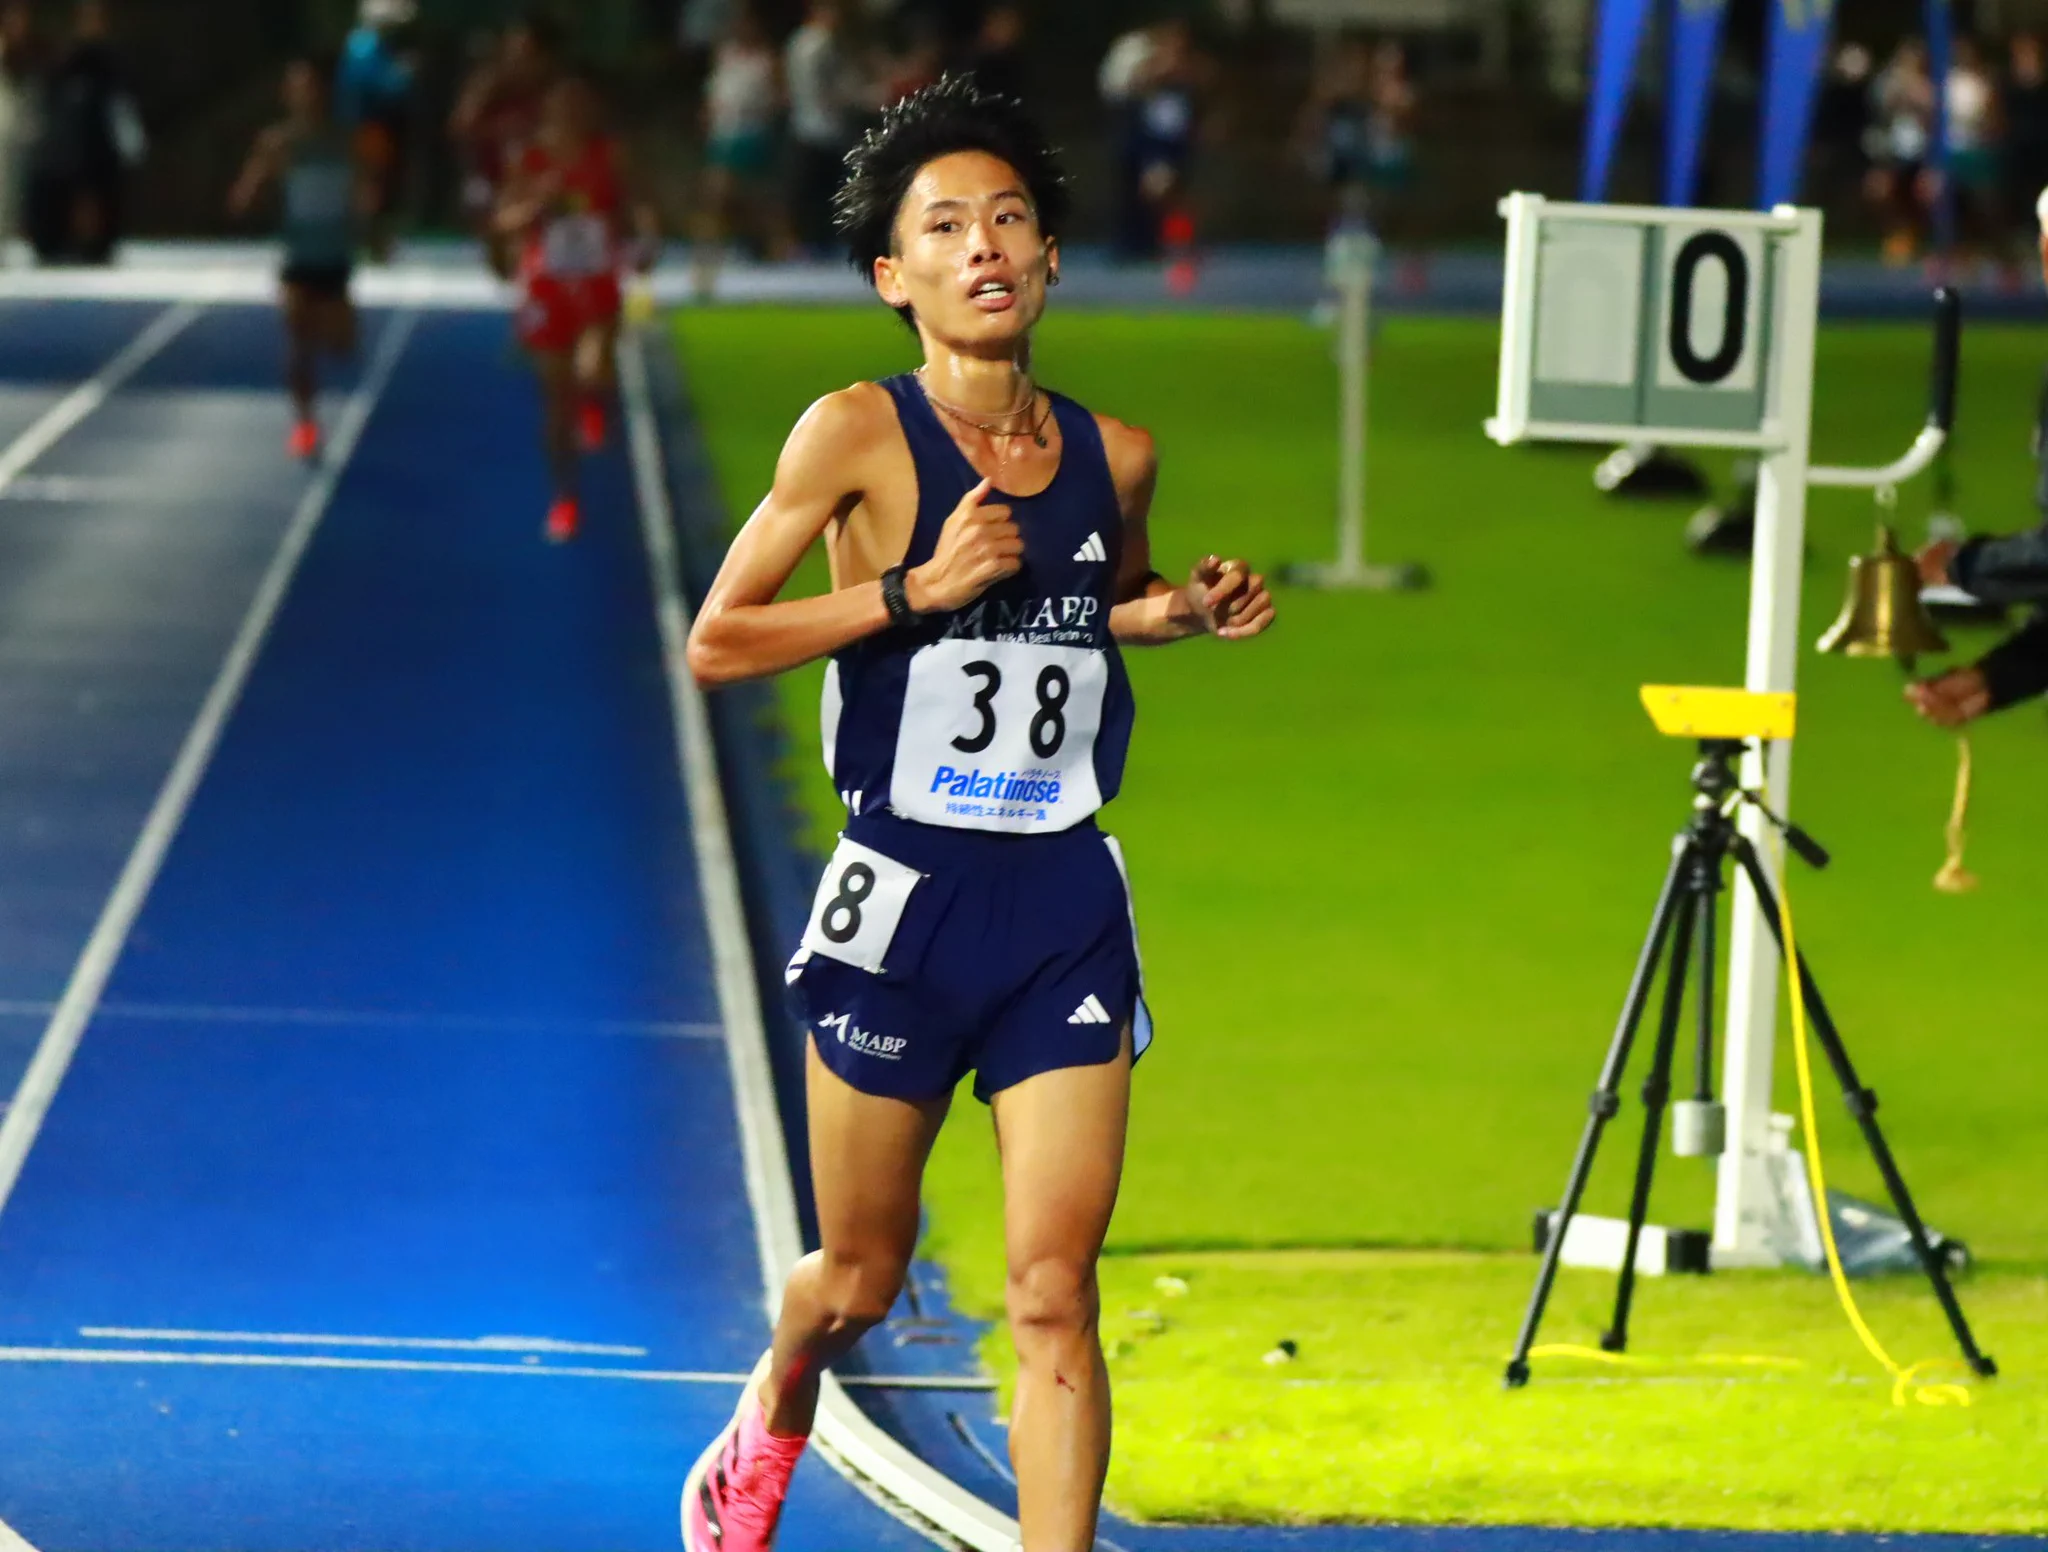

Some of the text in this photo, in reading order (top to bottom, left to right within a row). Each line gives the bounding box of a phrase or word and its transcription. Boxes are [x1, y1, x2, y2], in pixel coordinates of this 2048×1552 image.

[1671, 229, 1748, 383] 0
[996, 596, 1098, 628] MABP
[929, 766, 1061, 804] Palatinose
[821, 862, 875, 943] 8
[850, 1026, 908, 1053] MABP
